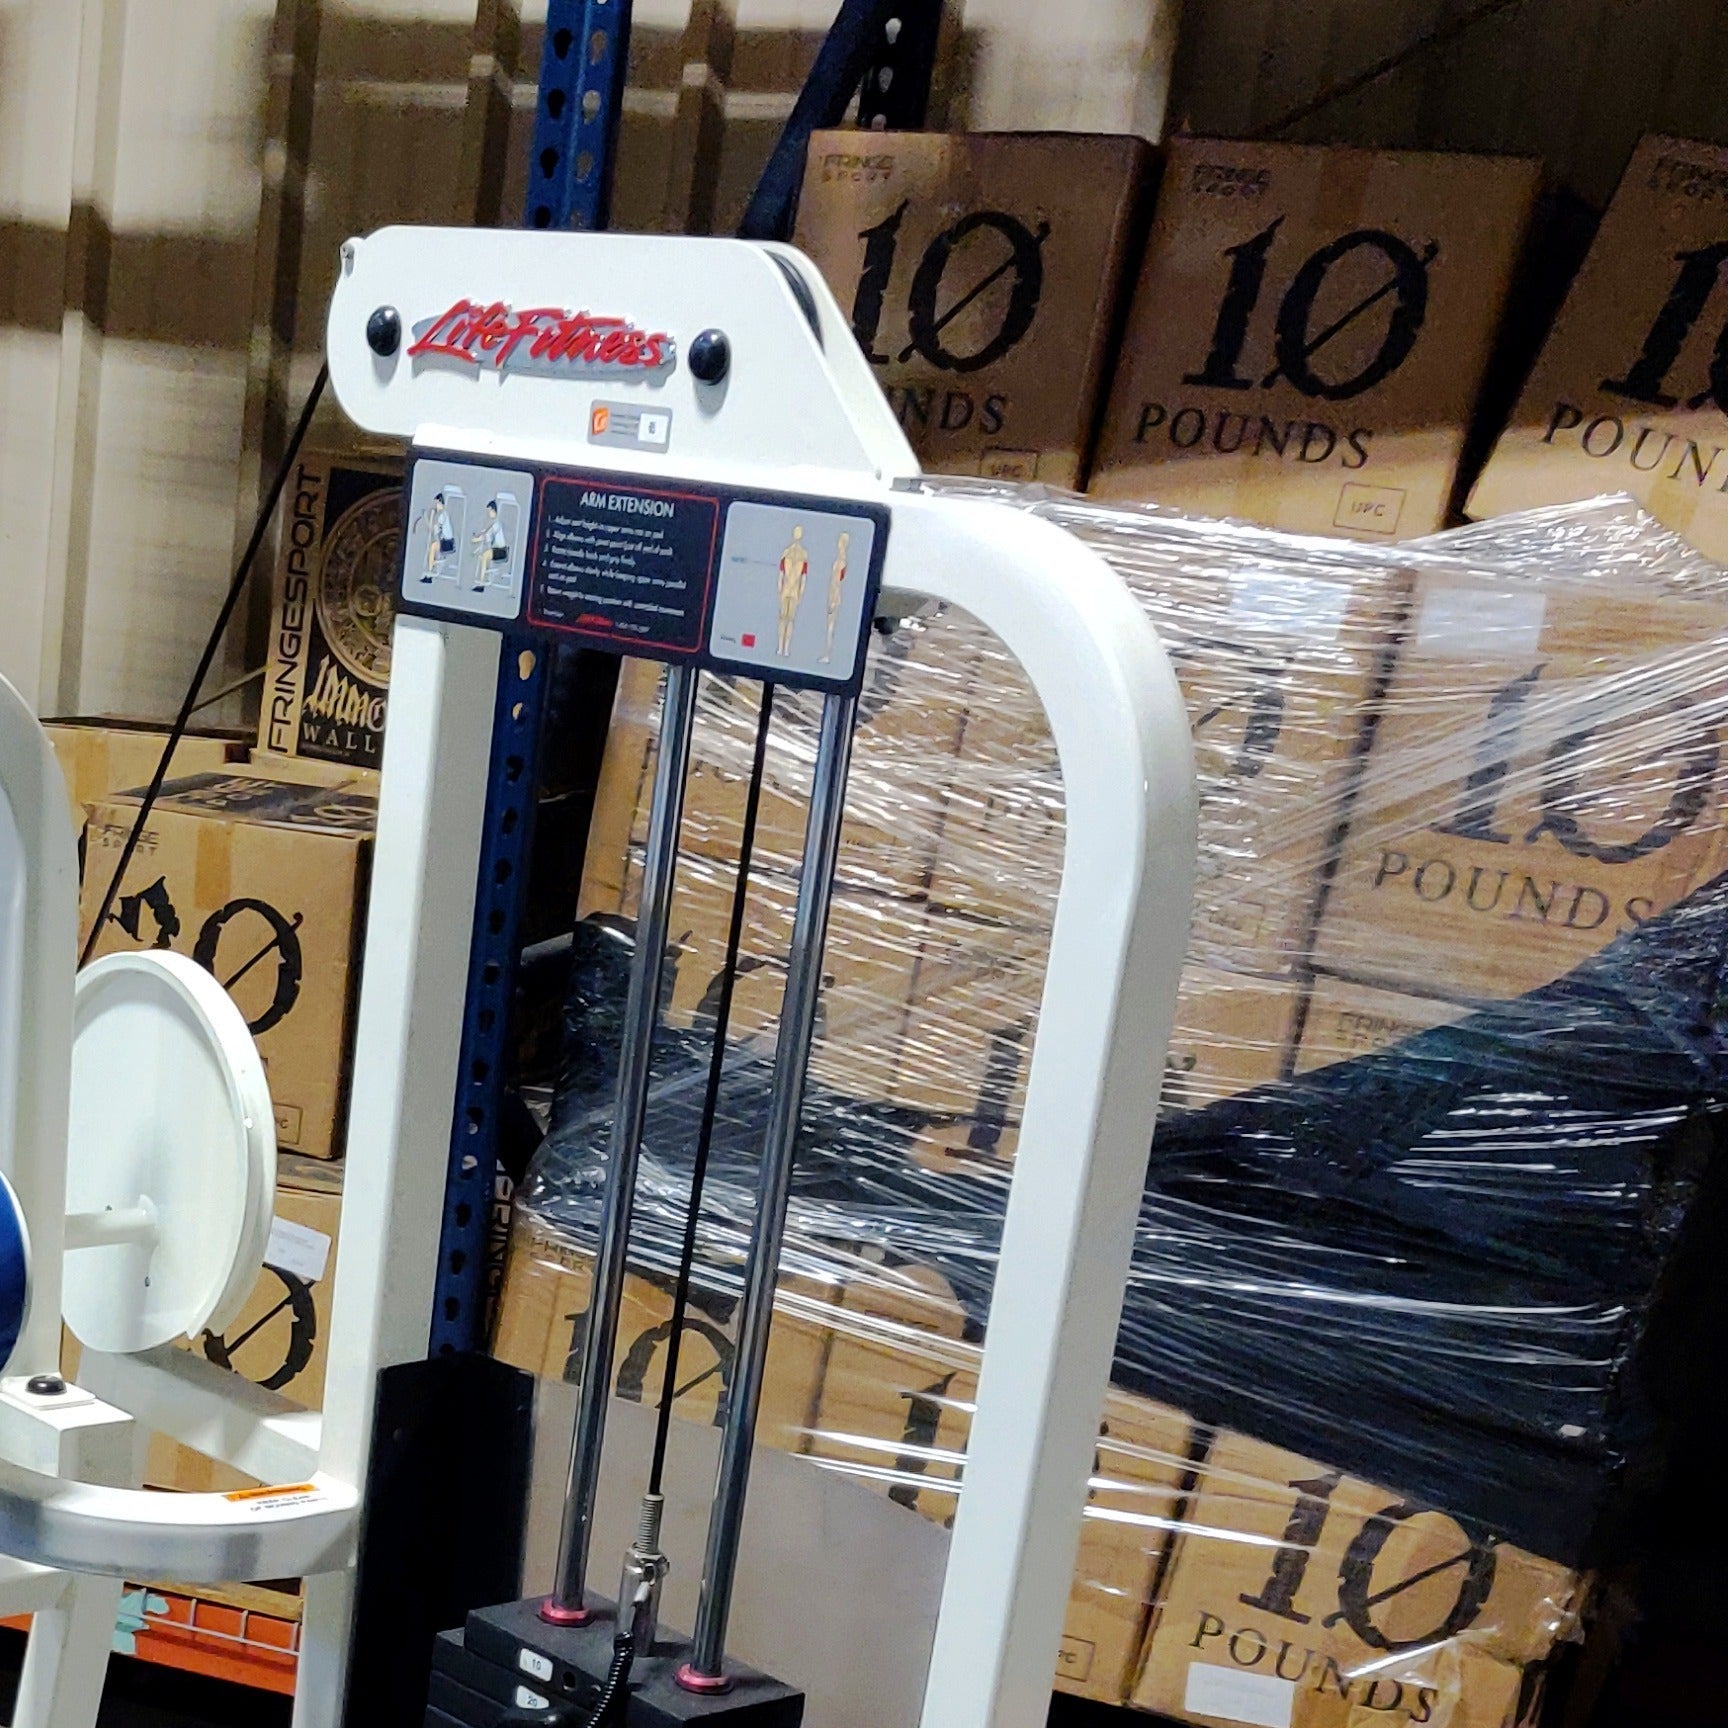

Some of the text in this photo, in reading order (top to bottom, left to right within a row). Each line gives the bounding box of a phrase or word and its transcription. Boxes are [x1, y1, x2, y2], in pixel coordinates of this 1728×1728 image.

[1597, 240, 1728, 417] 1
[1132, 402, 1375, 468] POUNDS
[1542, 401, 1728, 492] POUN
[580, 491, 675, 518] ARM EXTENSION
[1351, 500, 1386, 518] UPC
[267, 464, 321, 754] FRINGESPORT
[303, 722, 376, 754] WALL
[1373, 847, 1657, 938] POUNDS
[1238, 1474, 1498, 1651] 10
[1188, 1610, 1441, 1725] POUNDS
